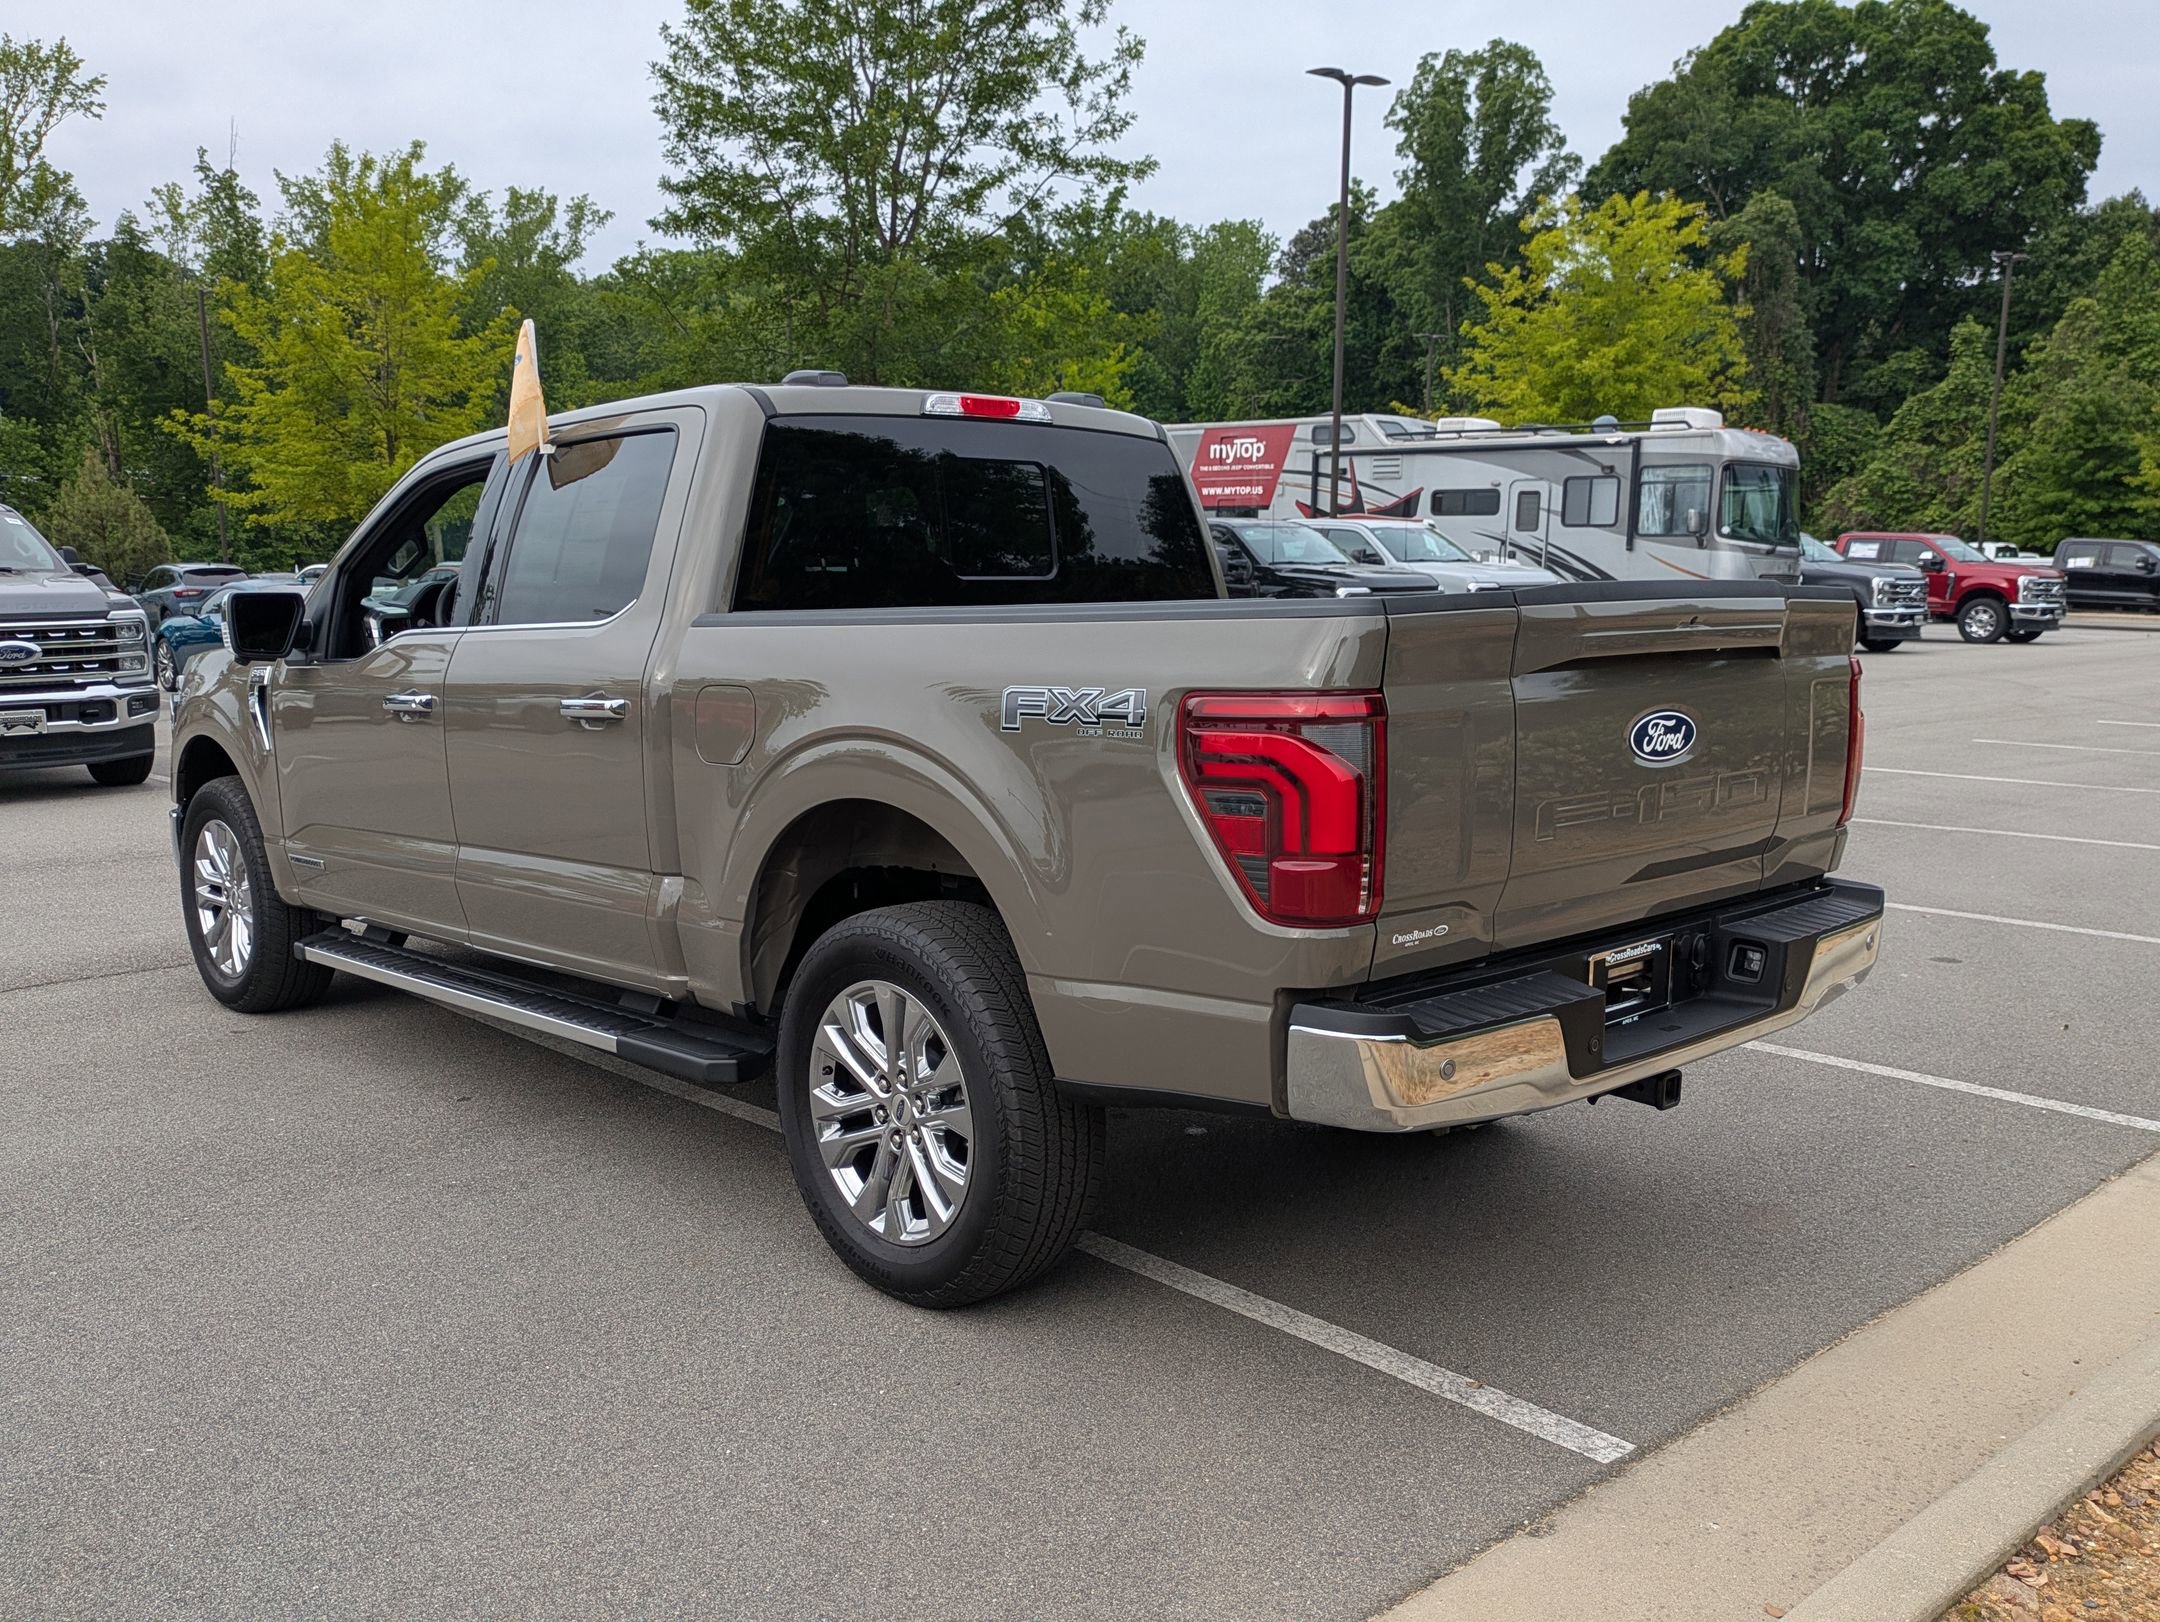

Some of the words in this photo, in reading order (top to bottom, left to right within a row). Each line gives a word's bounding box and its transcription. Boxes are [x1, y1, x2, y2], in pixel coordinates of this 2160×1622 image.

[1201, 486, 1264, 496] WWW.MYTOP.US
[1000, 685, 1147, 732] FX4
[1077, 727, 1103, 737] OFF
[1107, 728, 1143, 739] ROAD
[1643, 719, 1686, 753] Ford
